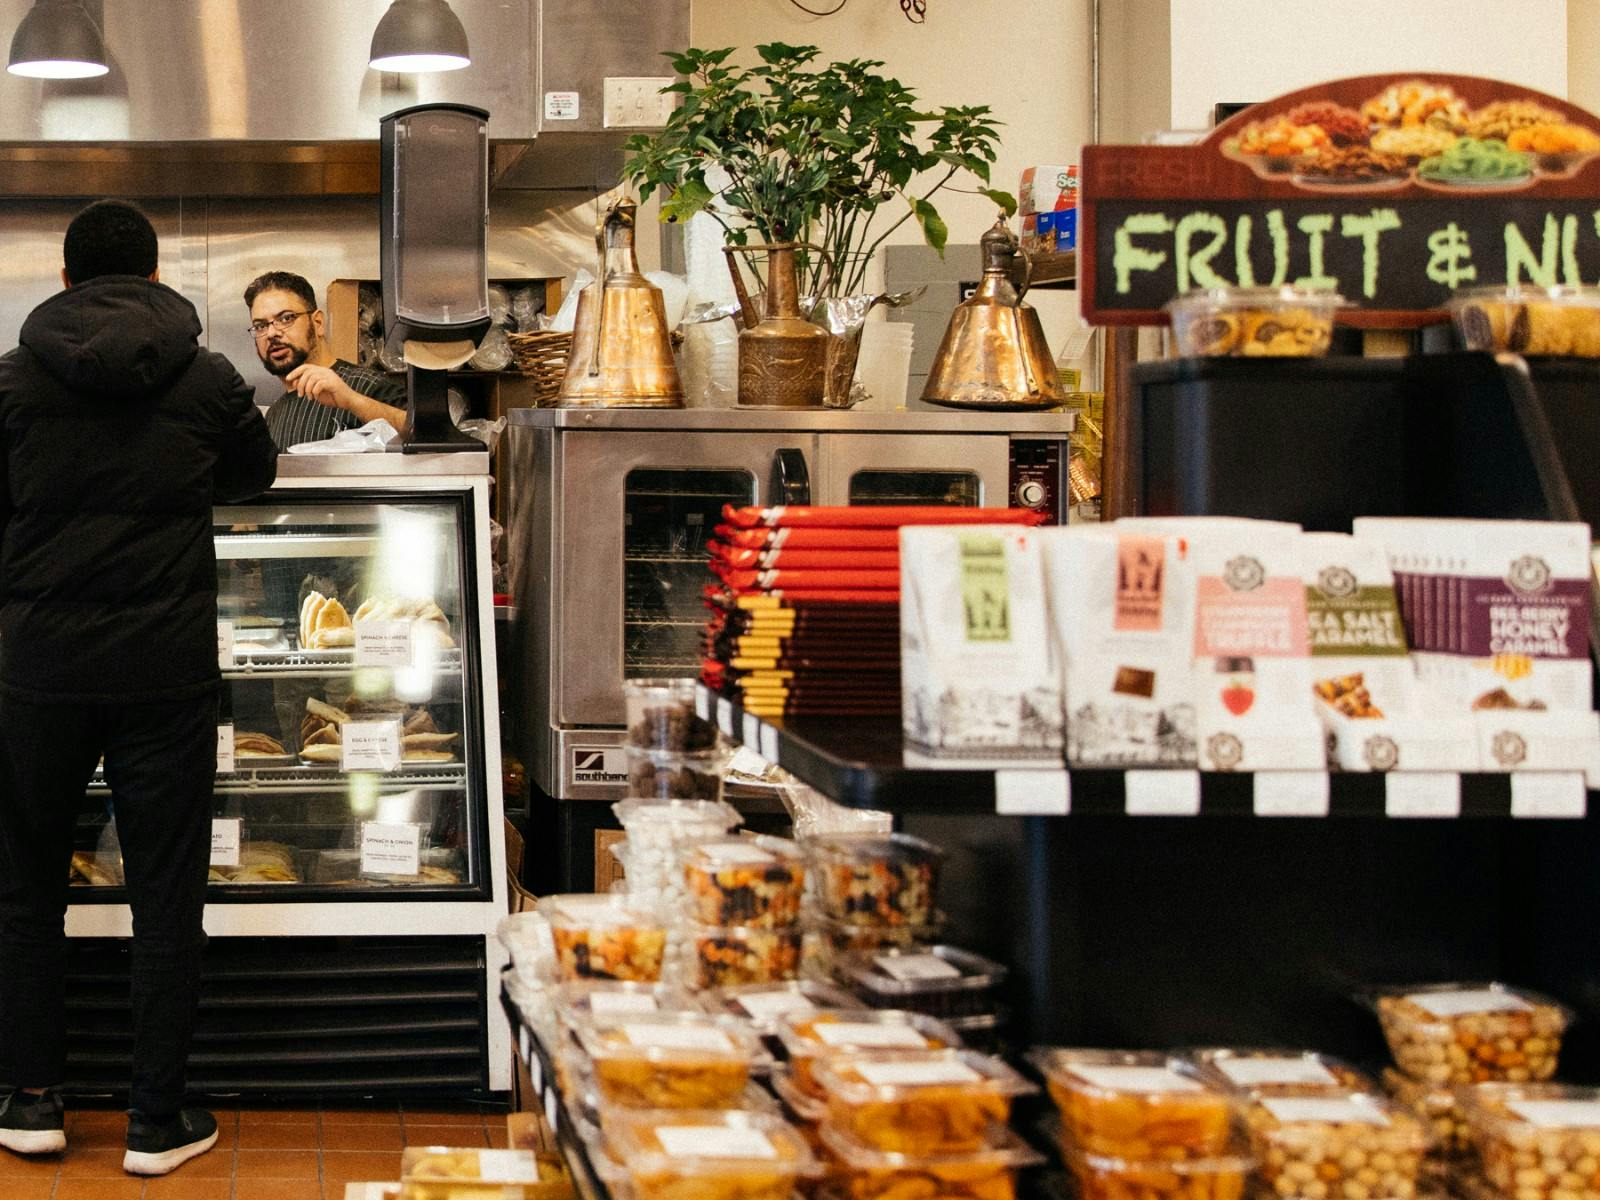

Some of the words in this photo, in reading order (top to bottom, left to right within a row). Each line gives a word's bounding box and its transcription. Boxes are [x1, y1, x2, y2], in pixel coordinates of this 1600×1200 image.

[1113, 208, 1402, 298] FRUIT
[1426, 222, 1478, 290] &
[1308, 611, 1341, 628] EA
[1491, 619, 1570, 639] HONEY
[1308, 629, 1401, 648] ARAMEL
[1489, 637, 1569, 656] CARAMEL
